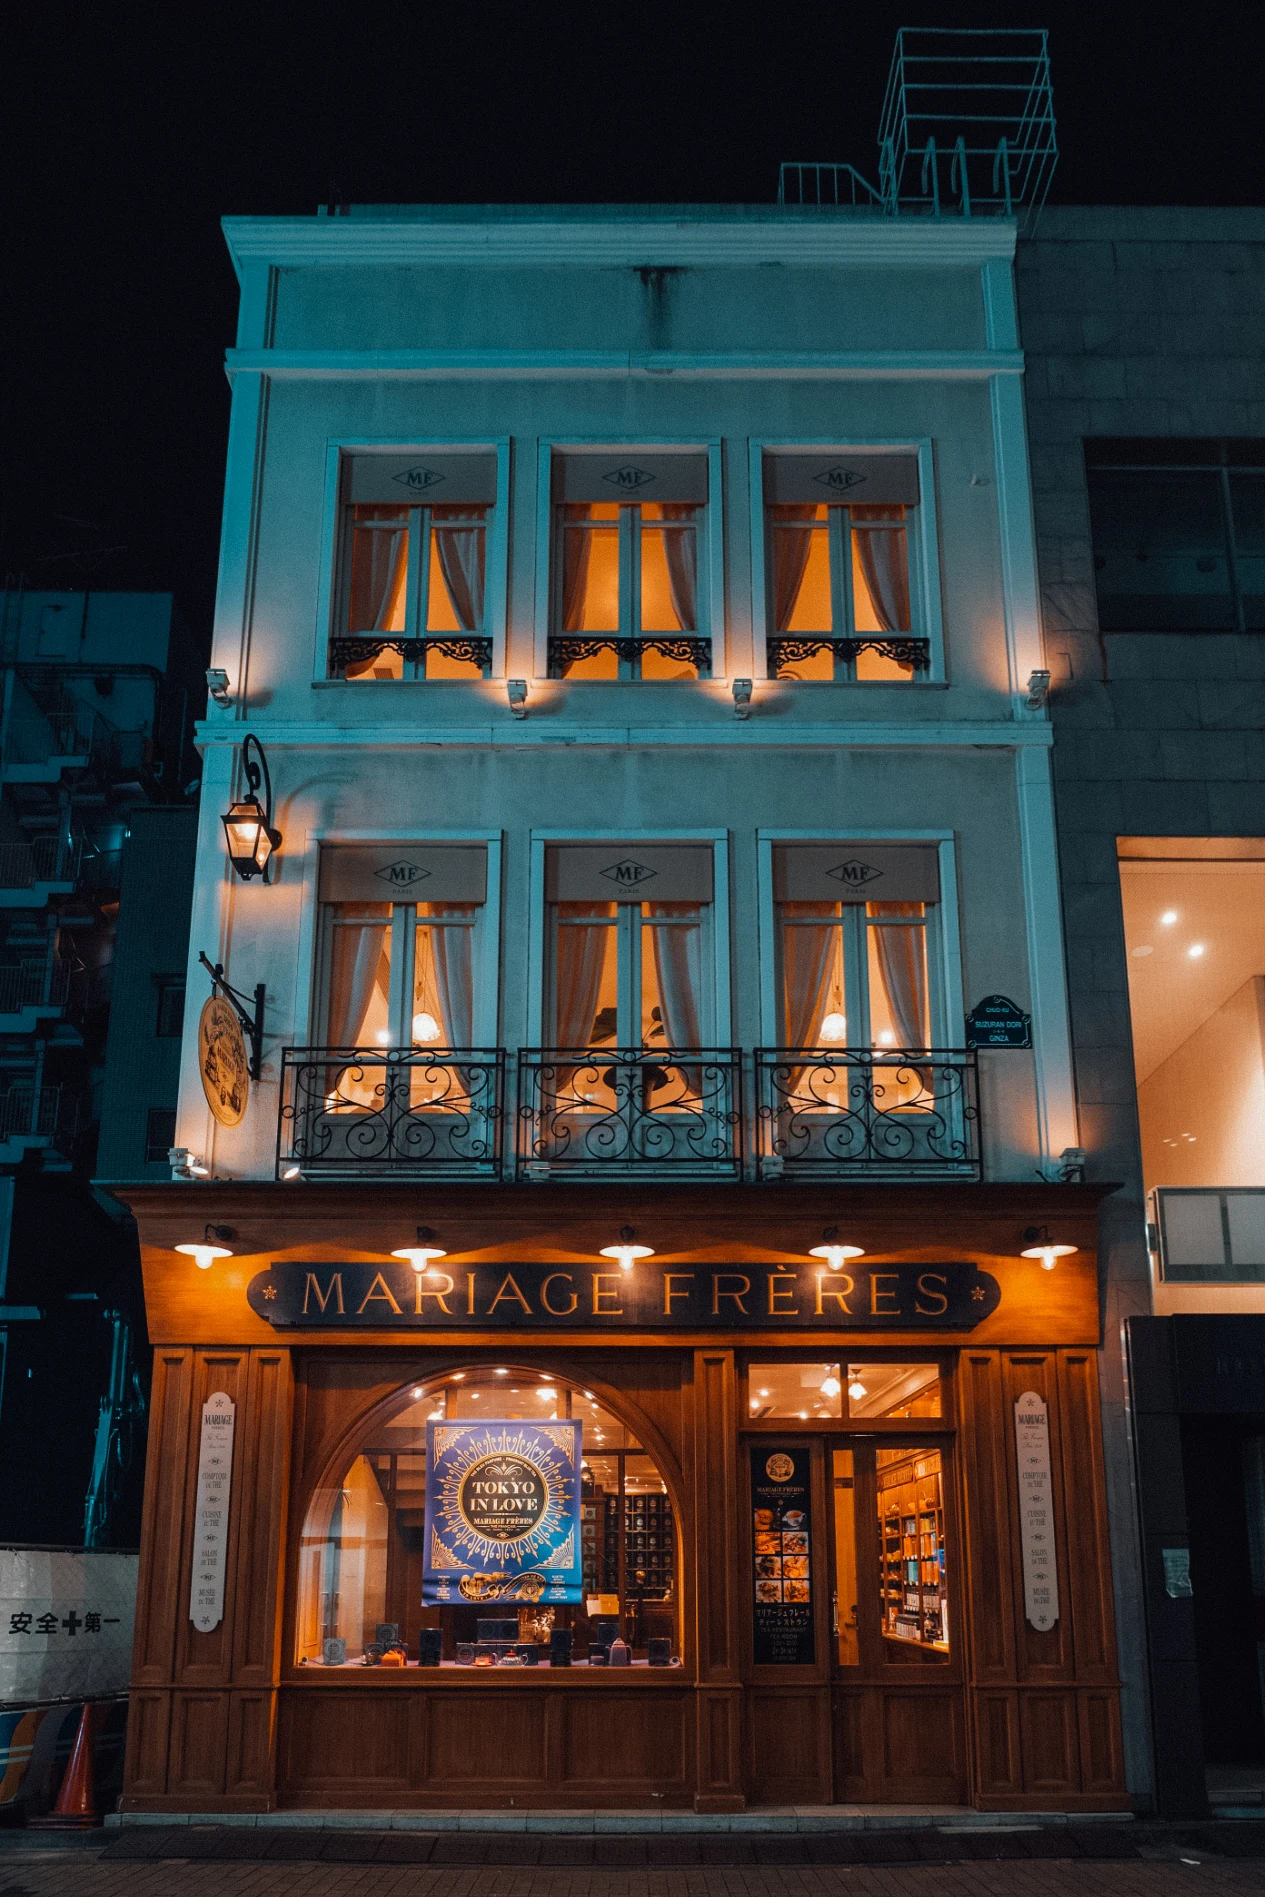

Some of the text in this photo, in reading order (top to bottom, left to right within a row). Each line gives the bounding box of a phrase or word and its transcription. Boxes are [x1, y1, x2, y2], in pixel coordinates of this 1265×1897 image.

[407, 472, 433, 483] MF
[617, 471, 642, 483] MF
[829, 472, 854, 484] MF
[389, 867, 417, 880] MF
[615, 866, 643, 880] MF
[842, 866, 869, 880] MF
[989, 1034, 1010, 1042] GINZA
[301, 1264, 948, 1316] MARIAGE FRÈRES
[204, 1414, 233, 1425] MARIAGE
[1018, 1413, 1046, 1425] MARIAGE
[472, 1480, 535, 1494] TOKYO
[470, 1498, 538, 1511] IN LOVE
[473, 1515, 533, 1525] MARIAGE FRÈRES
[9, 1611, 120, 1634] 安全 第一
